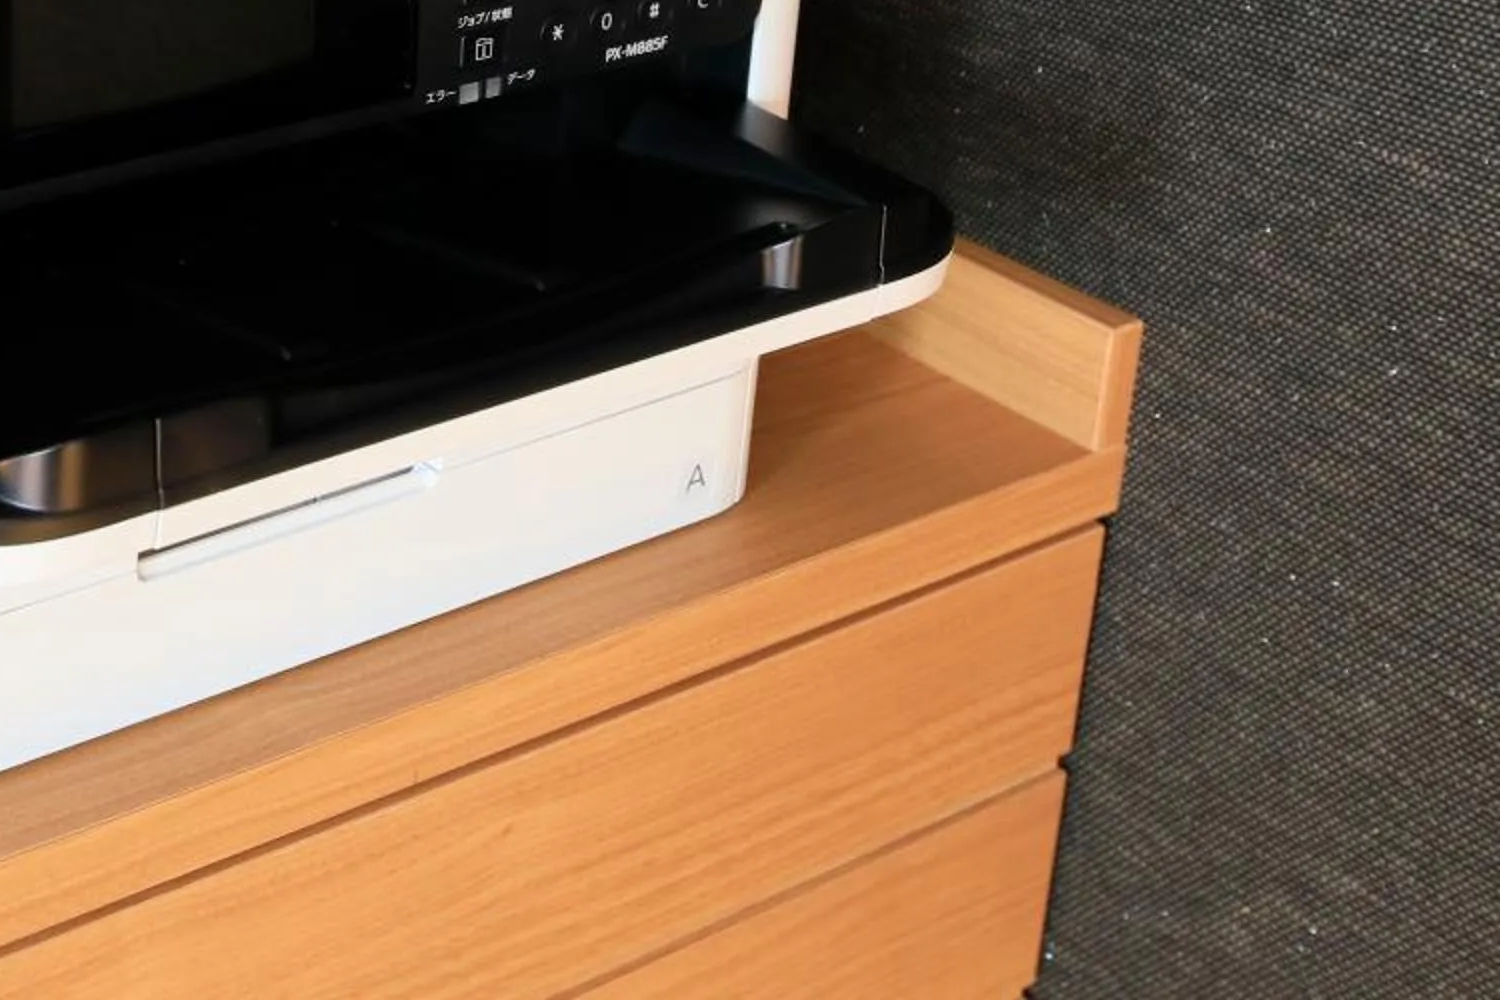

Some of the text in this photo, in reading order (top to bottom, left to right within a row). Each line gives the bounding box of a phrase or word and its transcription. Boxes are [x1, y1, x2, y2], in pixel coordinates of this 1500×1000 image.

[649, 2, 660, 18] #
[601, 12, 613, 31] 0
[605, 35, 668, 62] PX-M885F
[507, 68, 536, 85] データ
[426, 89, 457, 104] エラー
[685, 463, 706, 494] A
